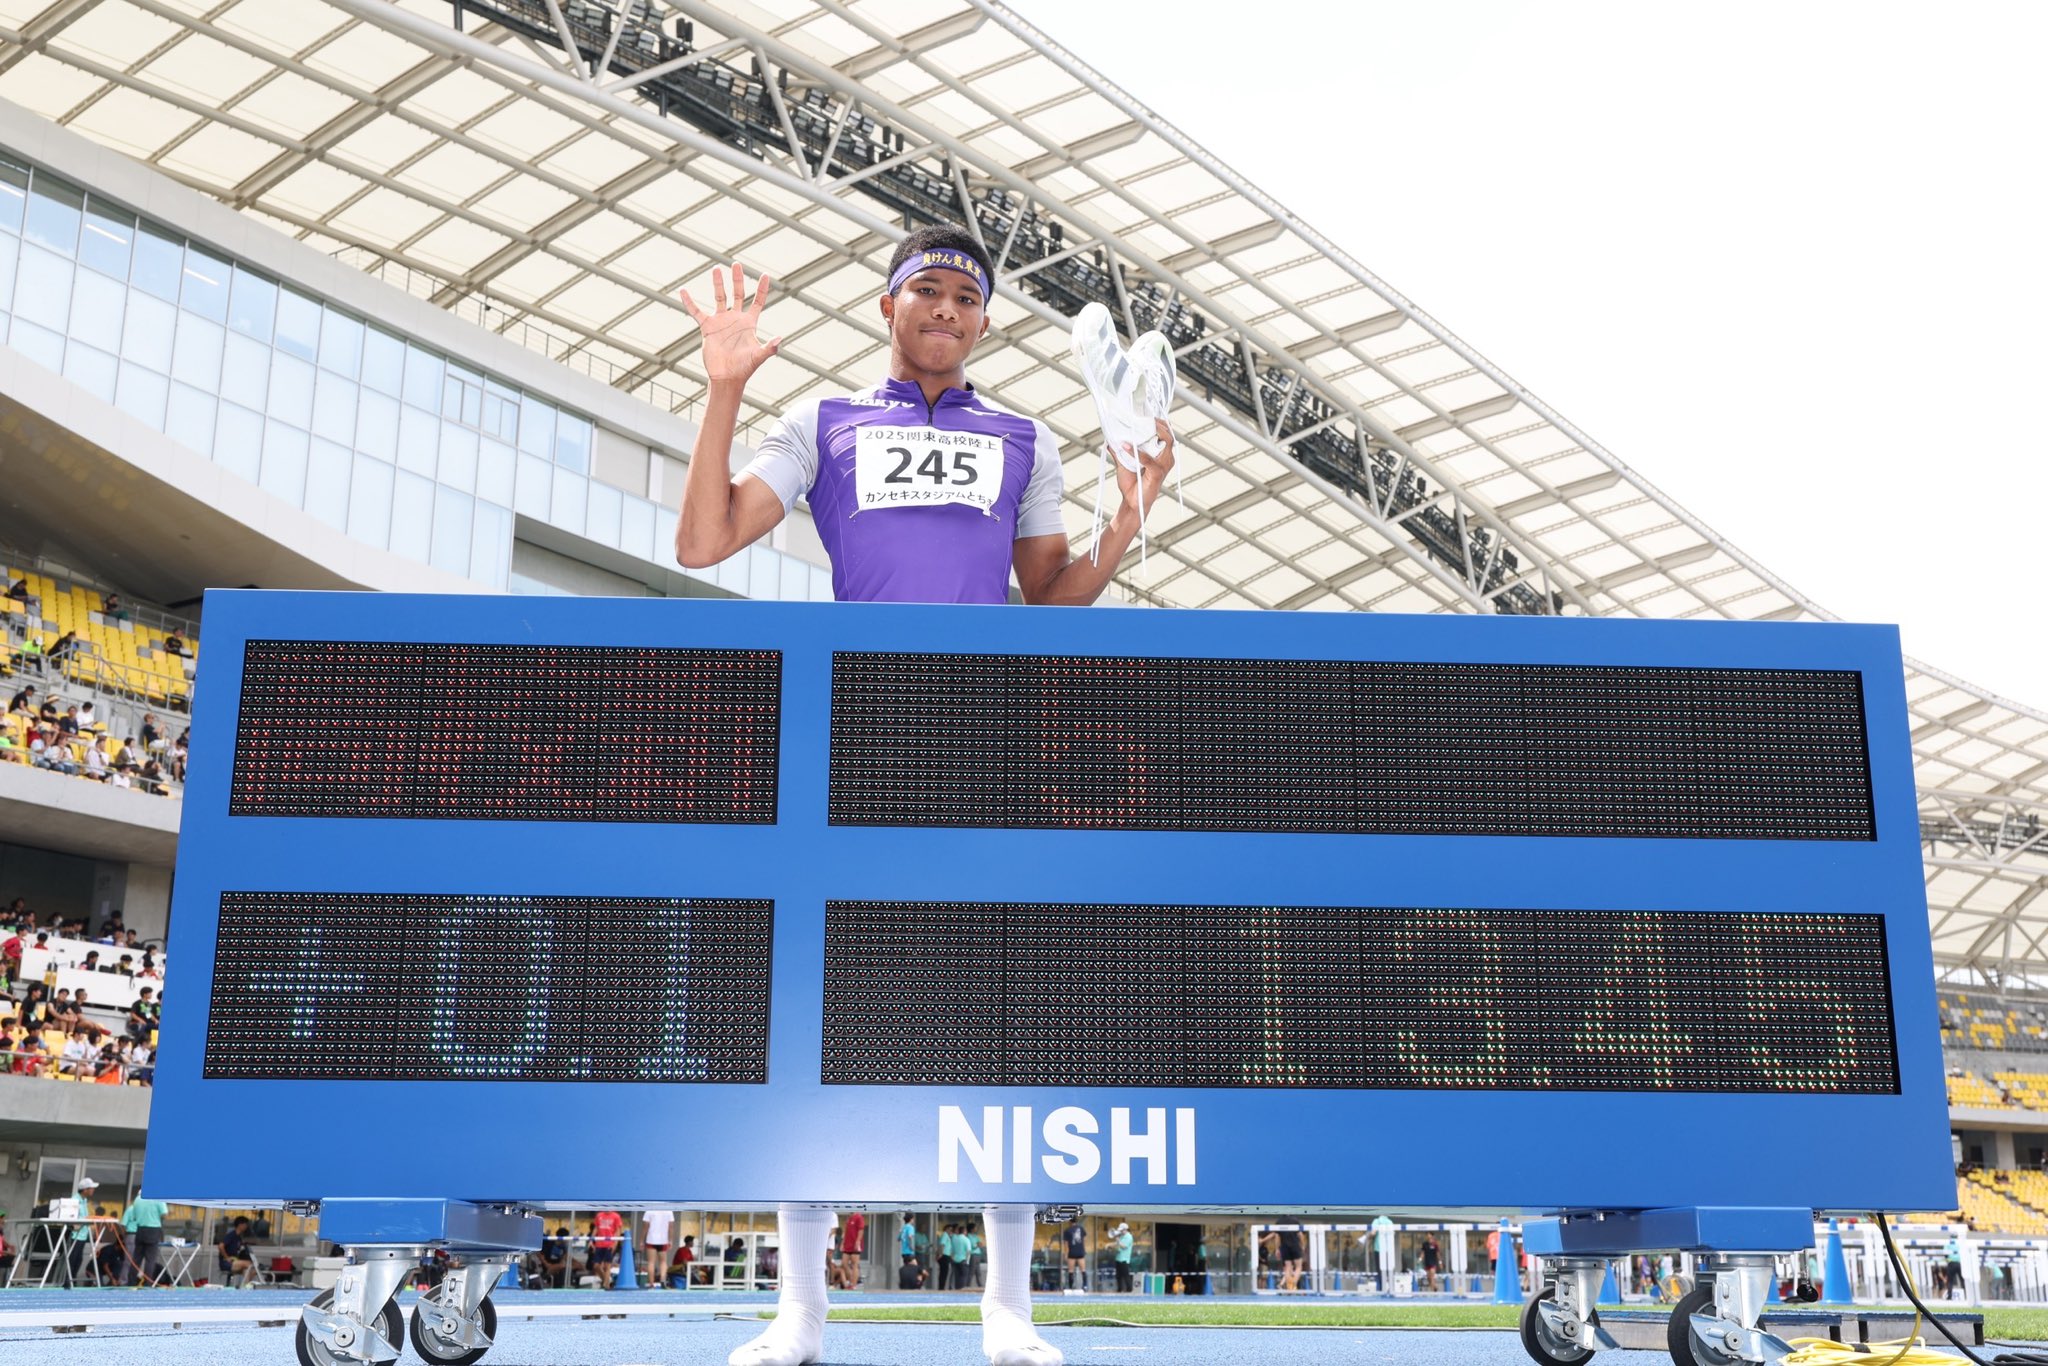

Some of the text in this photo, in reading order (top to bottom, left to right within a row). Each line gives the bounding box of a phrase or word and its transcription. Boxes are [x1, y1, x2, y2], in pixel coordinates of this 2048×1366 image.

[864, 430, 998, 451] 2025関東高校陸上
[884, 447, 978, 486] 245
[1040, 657, 1147, 825] 5
[1240, 906, 1857, 1090] 13.45
[938, 1106, 1196, 1186] NISHI
